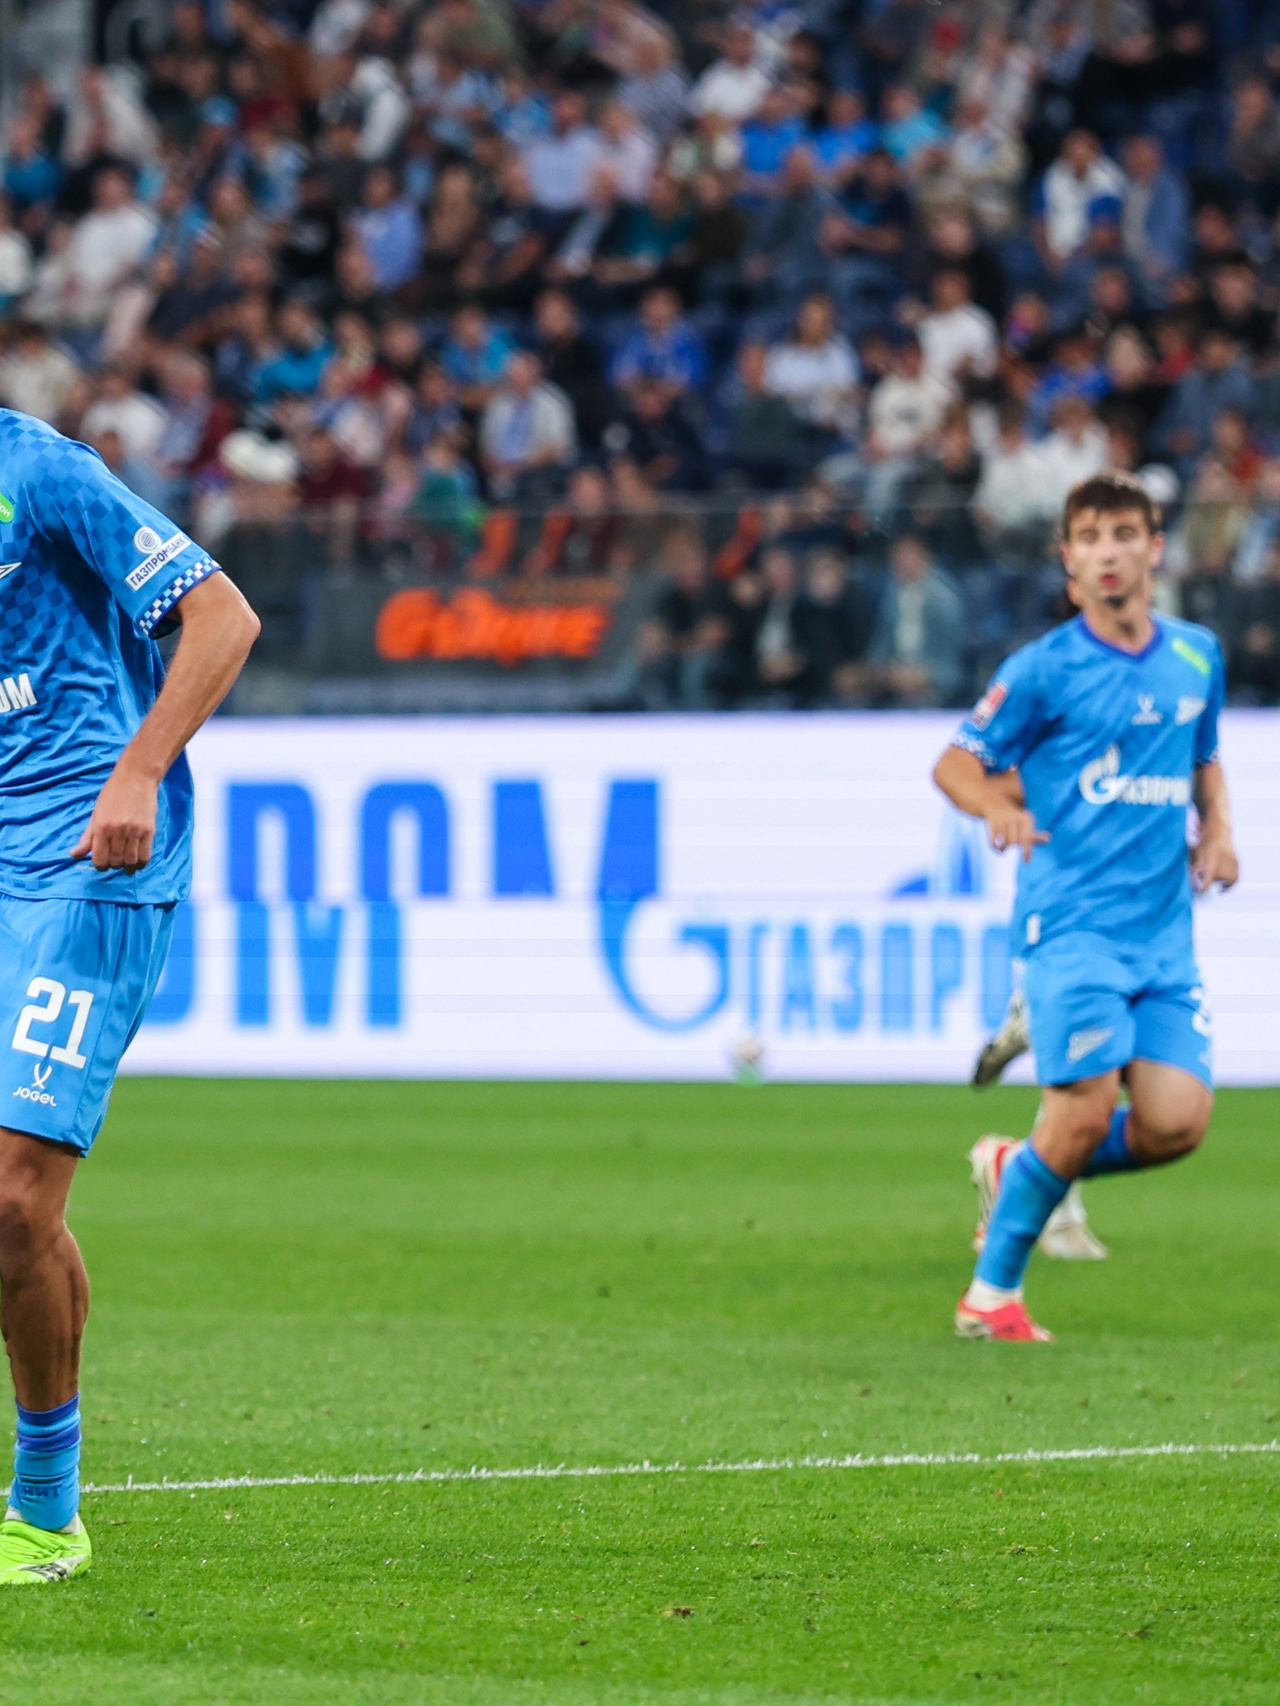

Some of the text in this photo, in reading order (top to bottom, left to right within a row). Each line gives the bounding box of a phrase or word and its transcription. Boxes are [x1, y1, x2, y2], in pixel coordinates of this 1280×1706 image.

[129, 536, 187, 586] ГАЗПРОМБАНК
[11, 976, 95, 1070] 21
[742, 922, 1012, 1032] ГАЗПРО
